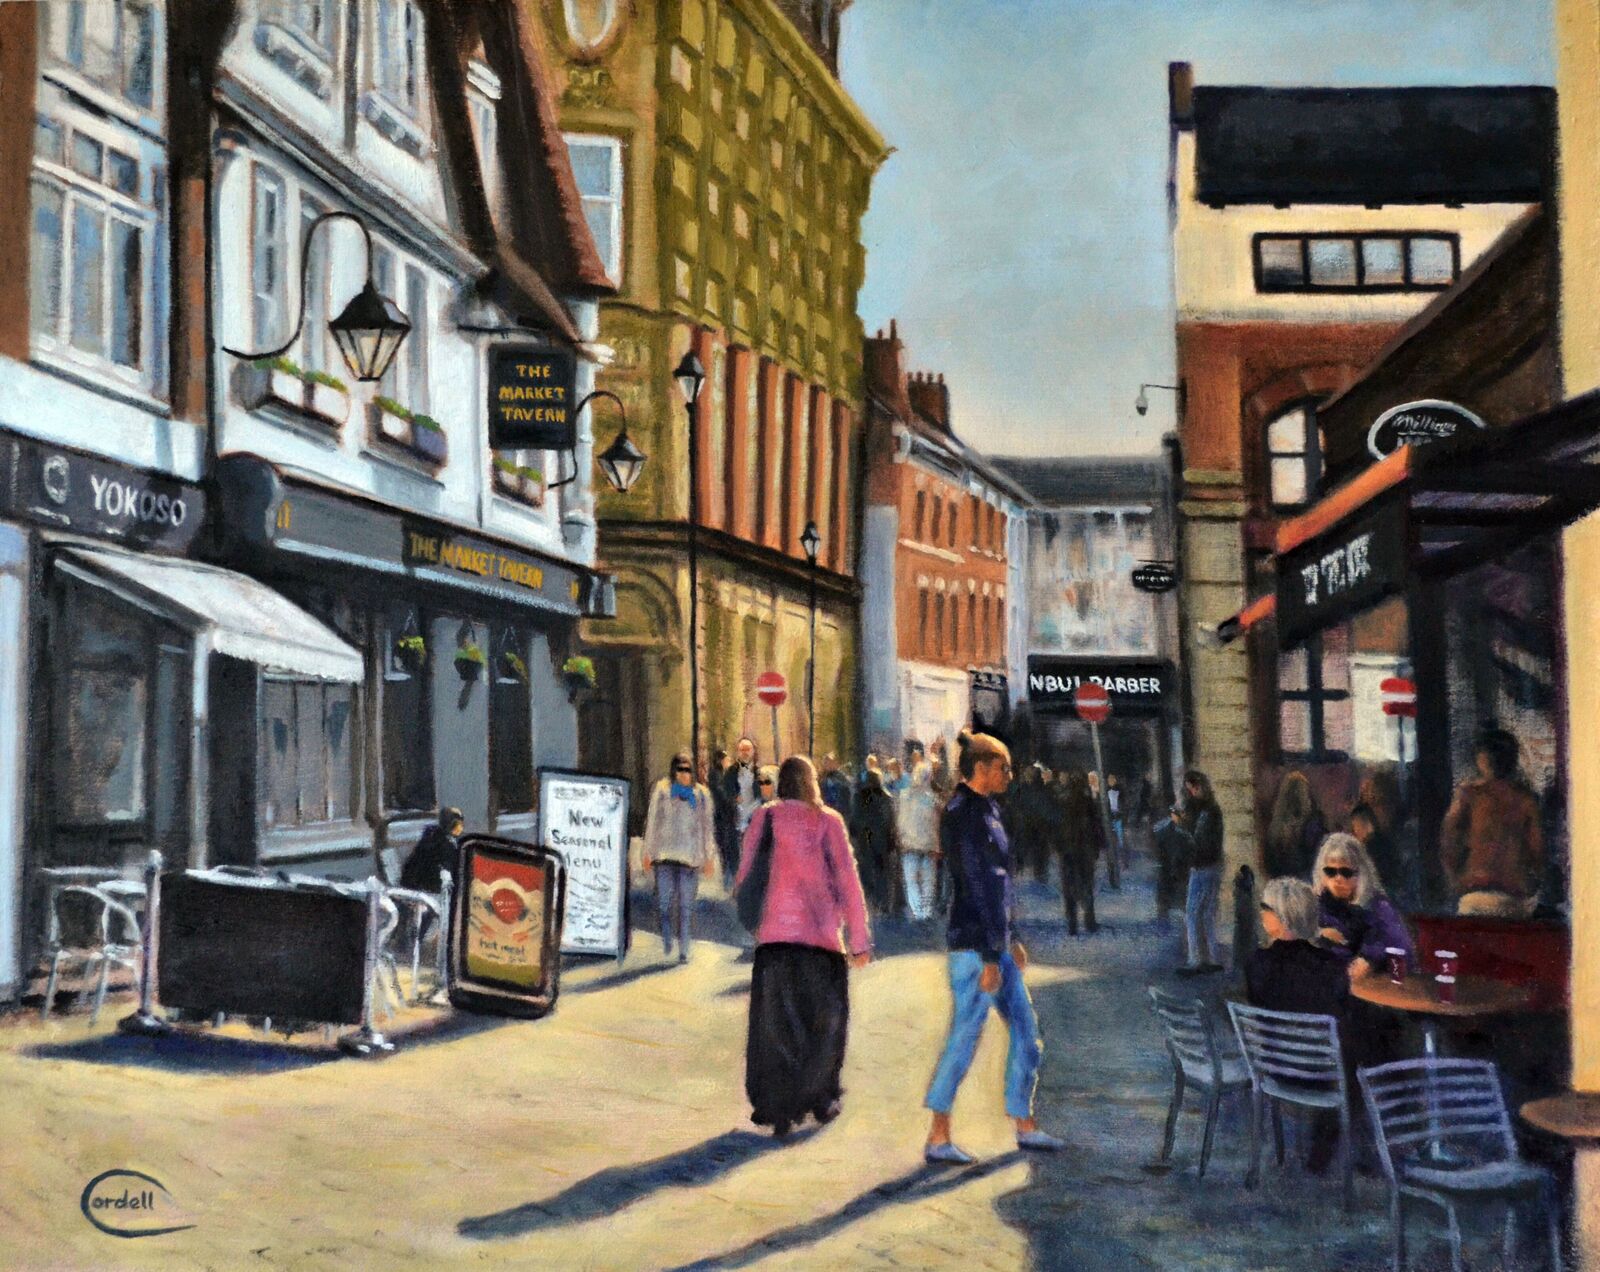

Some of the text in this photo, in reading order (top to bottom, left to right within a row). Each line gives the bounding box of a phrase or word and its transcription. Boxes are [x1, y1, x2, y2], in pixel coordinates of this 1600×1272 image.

[515, 364, 552, 378] THE
[498, 386, 565, 401] MARKET
[501, 406, 566, 423] TAVERN
[90, 473, 187, 527] YOKOSO
[409, 532, 438, 559] THE
[439, 541, 496, 577] MARKET
[568, 808, 604, 829] New
[551, 828, 613, 850] Seasonal
